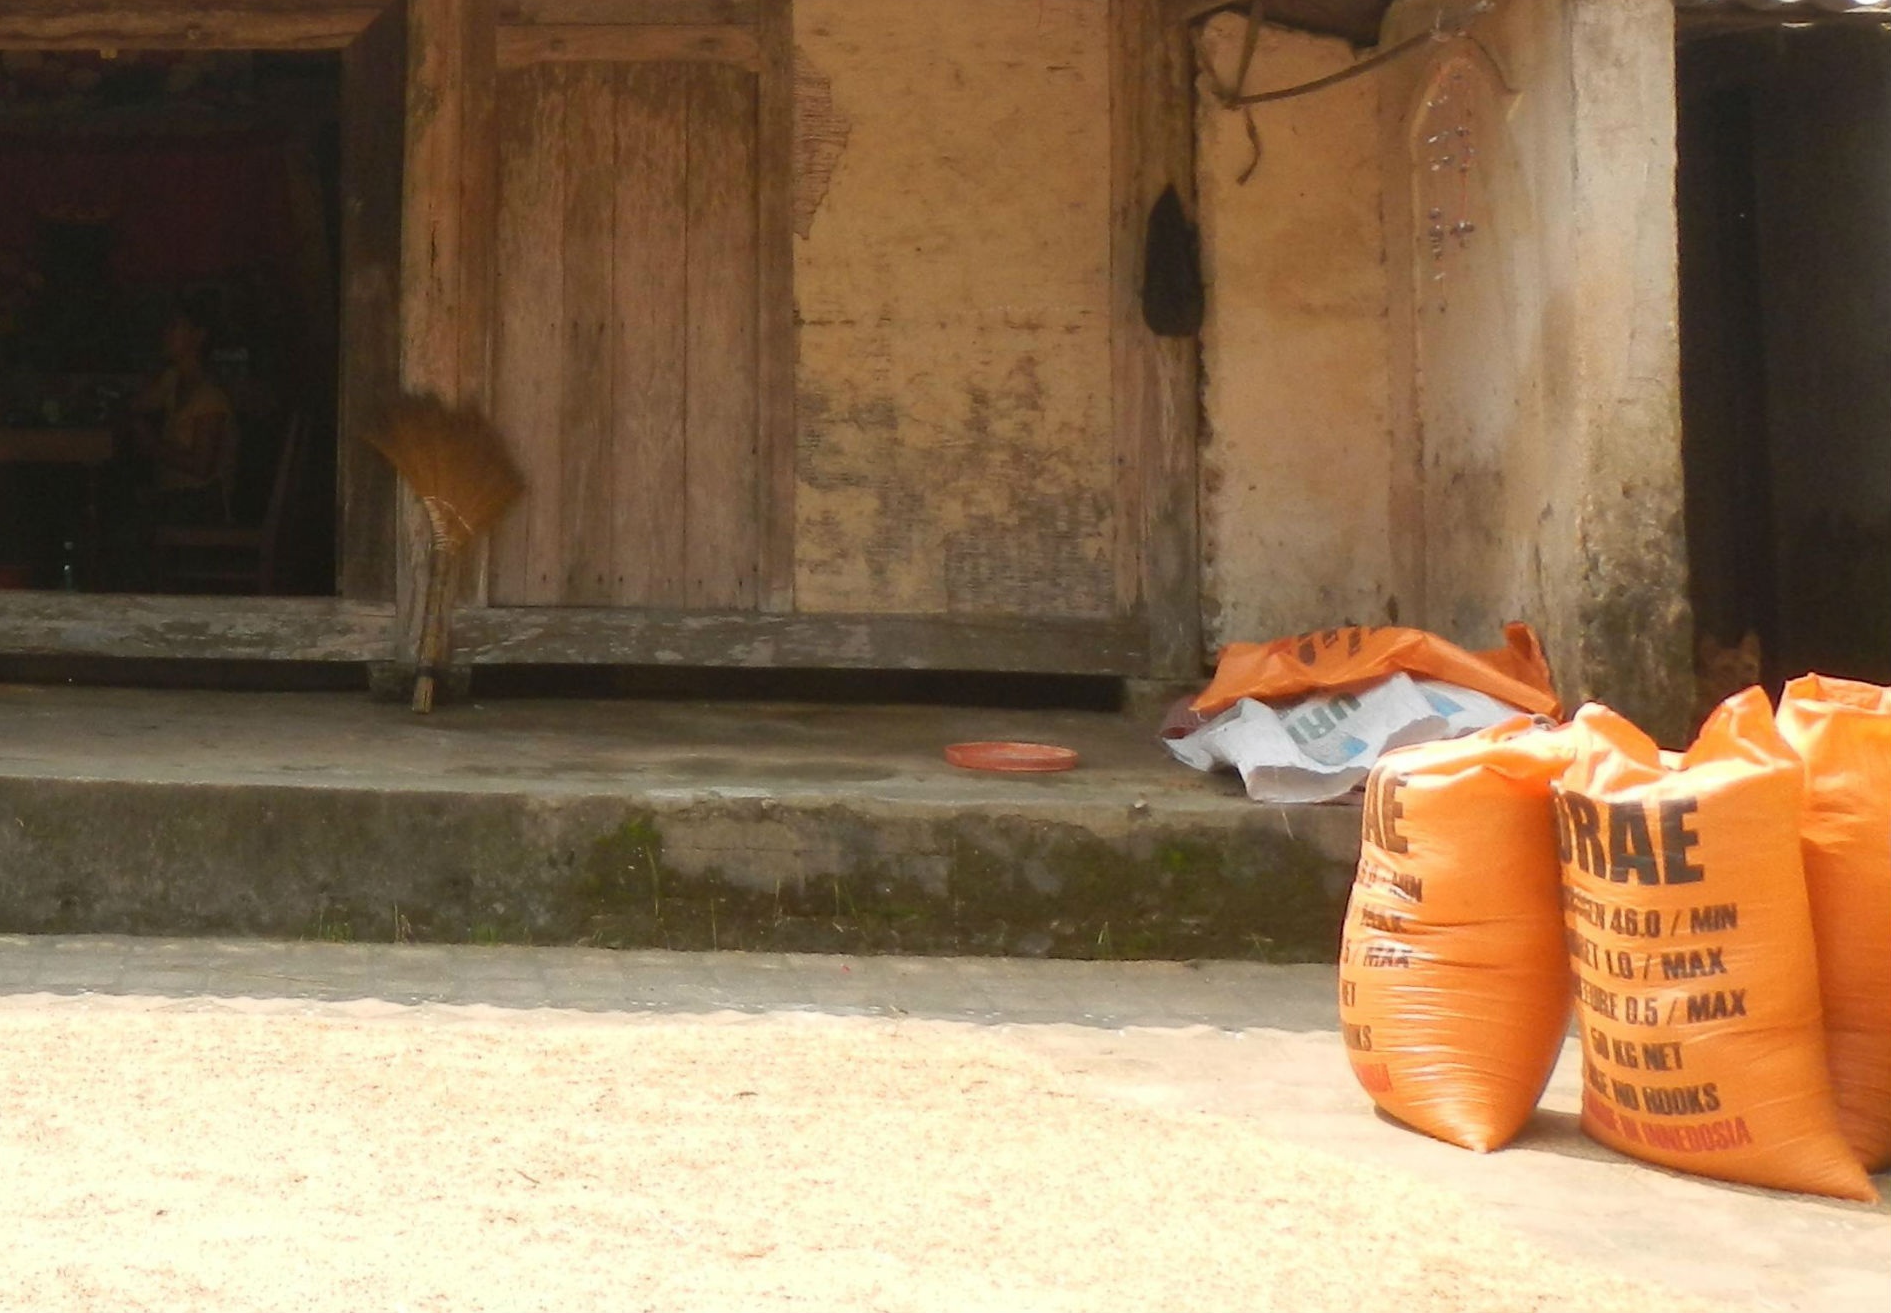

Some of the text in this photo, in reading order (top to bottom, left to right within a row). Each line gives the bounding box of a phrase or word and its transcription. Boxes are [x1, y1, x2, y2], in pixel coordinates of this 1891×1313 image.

[1610, 906, 1660, 938] 46.0
[1691, 903, 1738, 935] MIN
[1661, 946, 1728, 980] MAX
[1625, 996, 1658, 1026] 0.5
[1687, 988, 1747, 1023] MAX
[1642, 1042, 1683, 1071] NET
[1642, 1082, 1720, 1116] HOOKS
